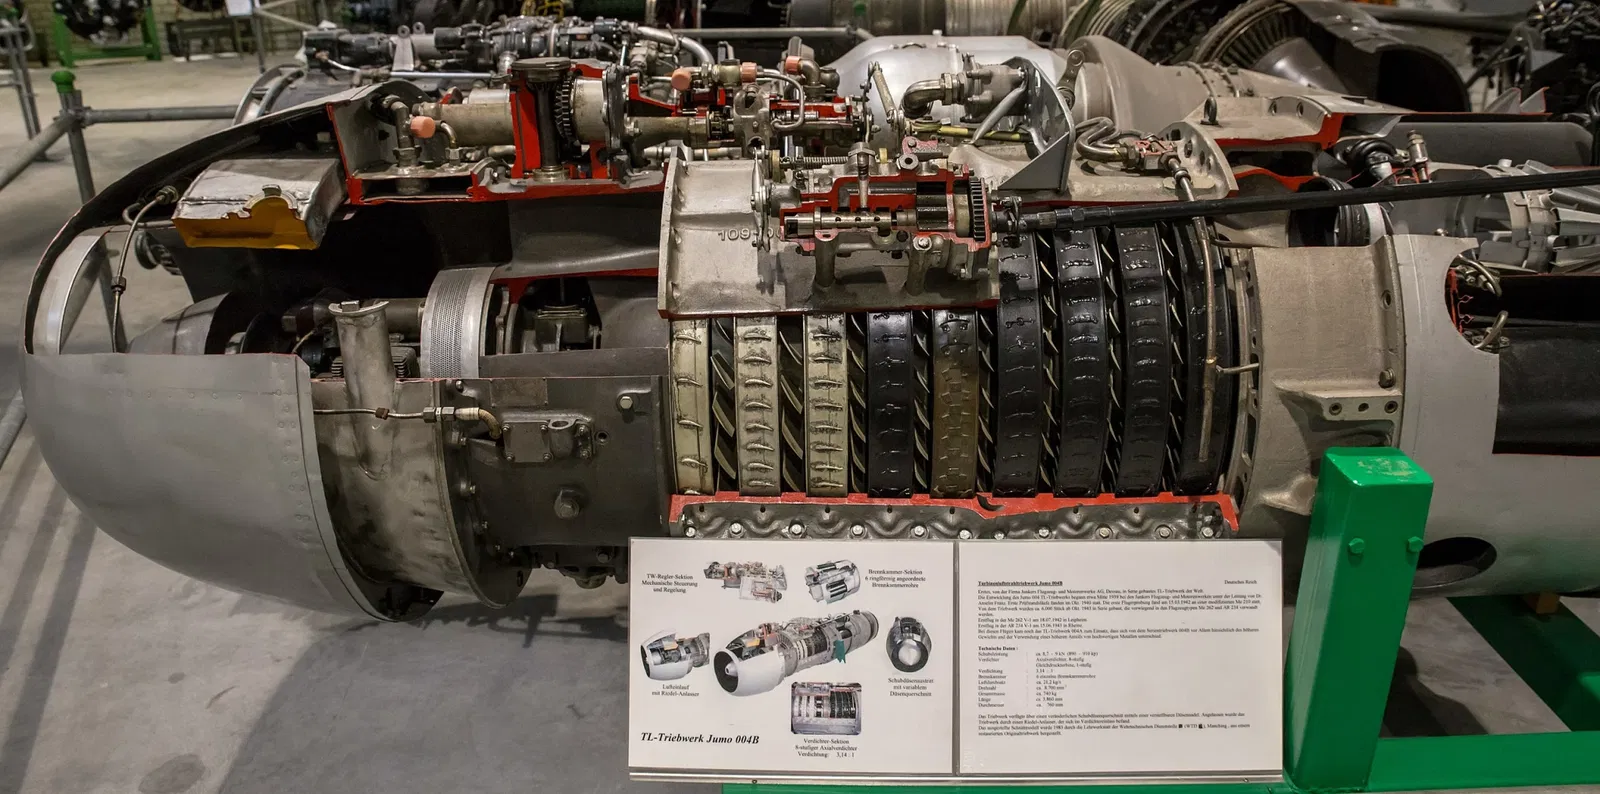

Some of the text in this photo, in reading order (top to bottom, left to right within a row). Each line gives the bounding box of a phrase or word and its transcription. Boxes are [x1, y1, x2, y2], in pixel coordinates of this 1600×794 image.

[869, 575, 896, 583] ringförmig
[673, 580, 698, 588] Steuerung
[641, 732, 760, 744] TL-Triebwerk Jumo 004B
